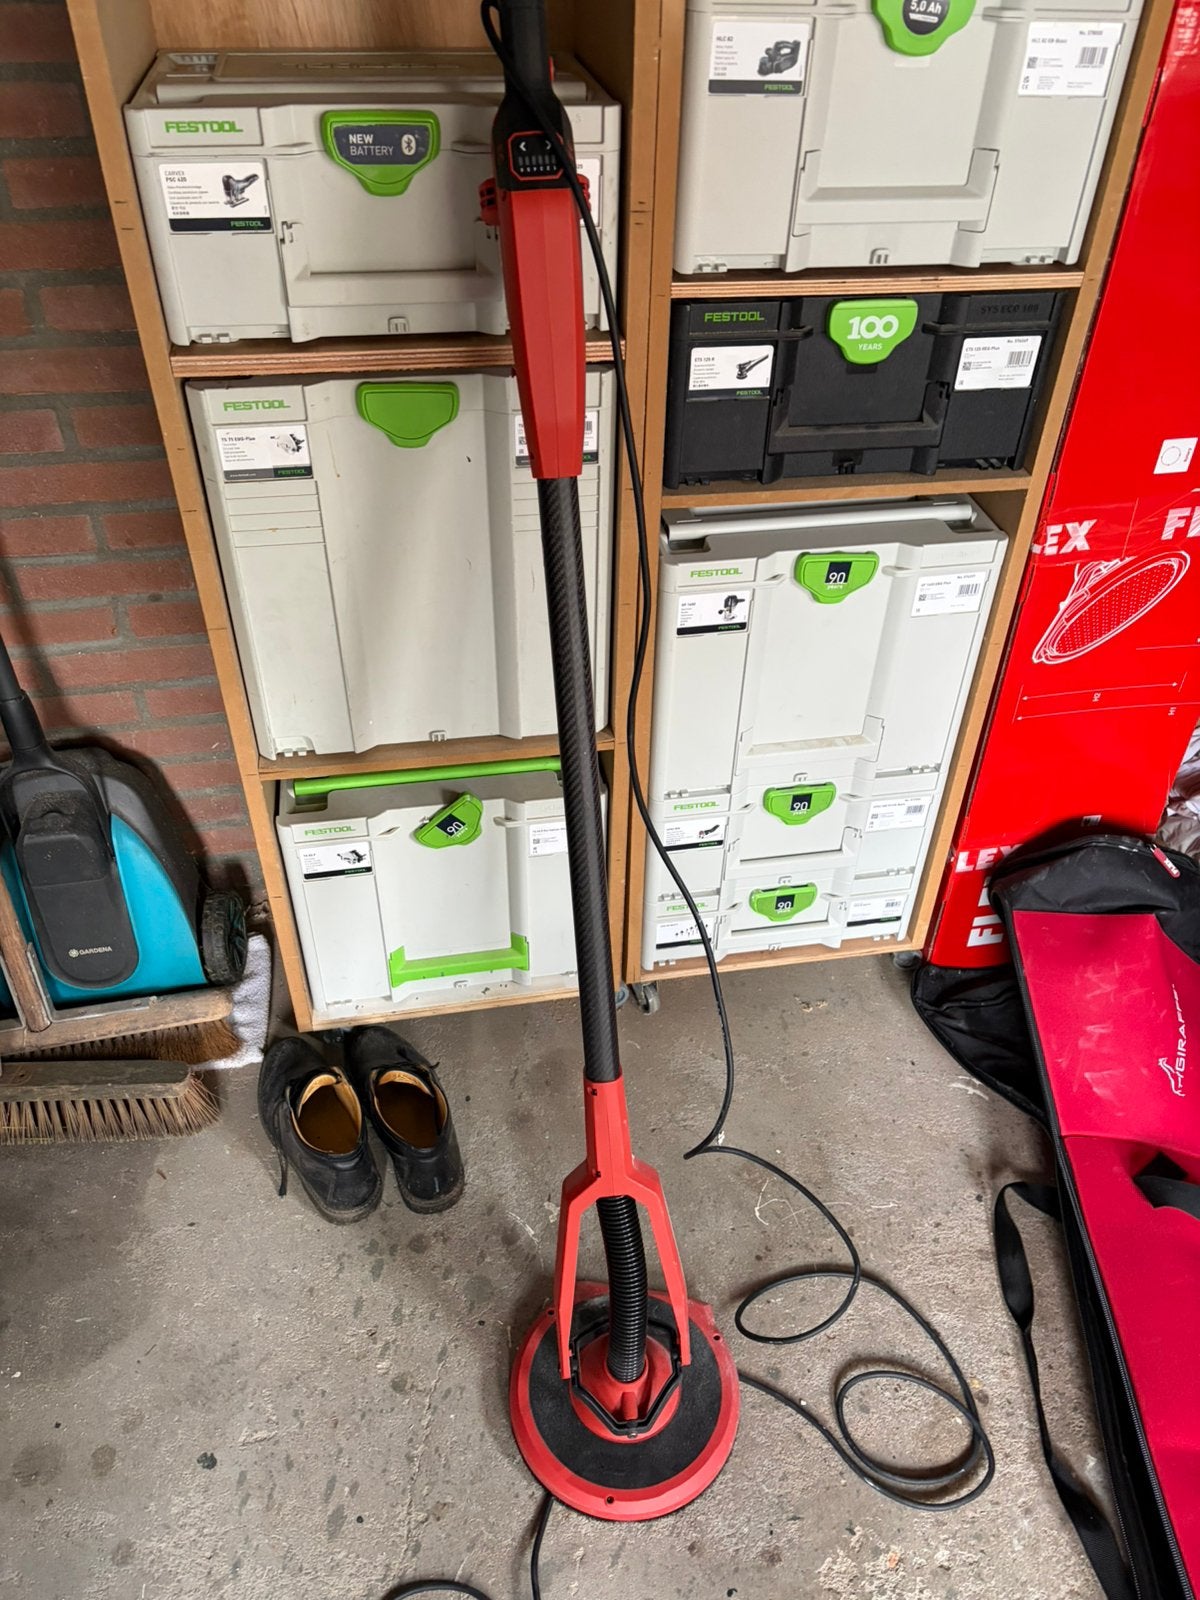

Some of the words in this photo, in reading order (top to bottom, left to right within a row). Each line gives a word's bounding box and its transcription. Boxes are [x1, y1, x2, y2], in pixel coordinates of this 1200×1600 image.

[909, 0, 927, 12] 5,0
[927, 1, 942, 14] Ah
[164, 121, 244, 133] FESTOOL
[348, 134, 374, 144] NEW
[350, 146, 394, 156] BATTERY
[981, 304, 998, 314] SYS
[1001, 304, 1020, 313] ECO
[704, 311, 765, 322] FESTOOL
[847, 315, 899, 339] 100
[223, 400, 291, 411] FESTOOL
[690, 567, 743, 578] FESTOOL
[829, 572, 846, 584] 90
[673, 801, 720, 811] FESTOOL
[793, 802, 808, 811] 90
[304, 825, 356, 836] FESTOOL
[446, 821, 464, 835] 90
[777, 901, 792, 910] 90
[79, 946, 112, 955] GARDENA
